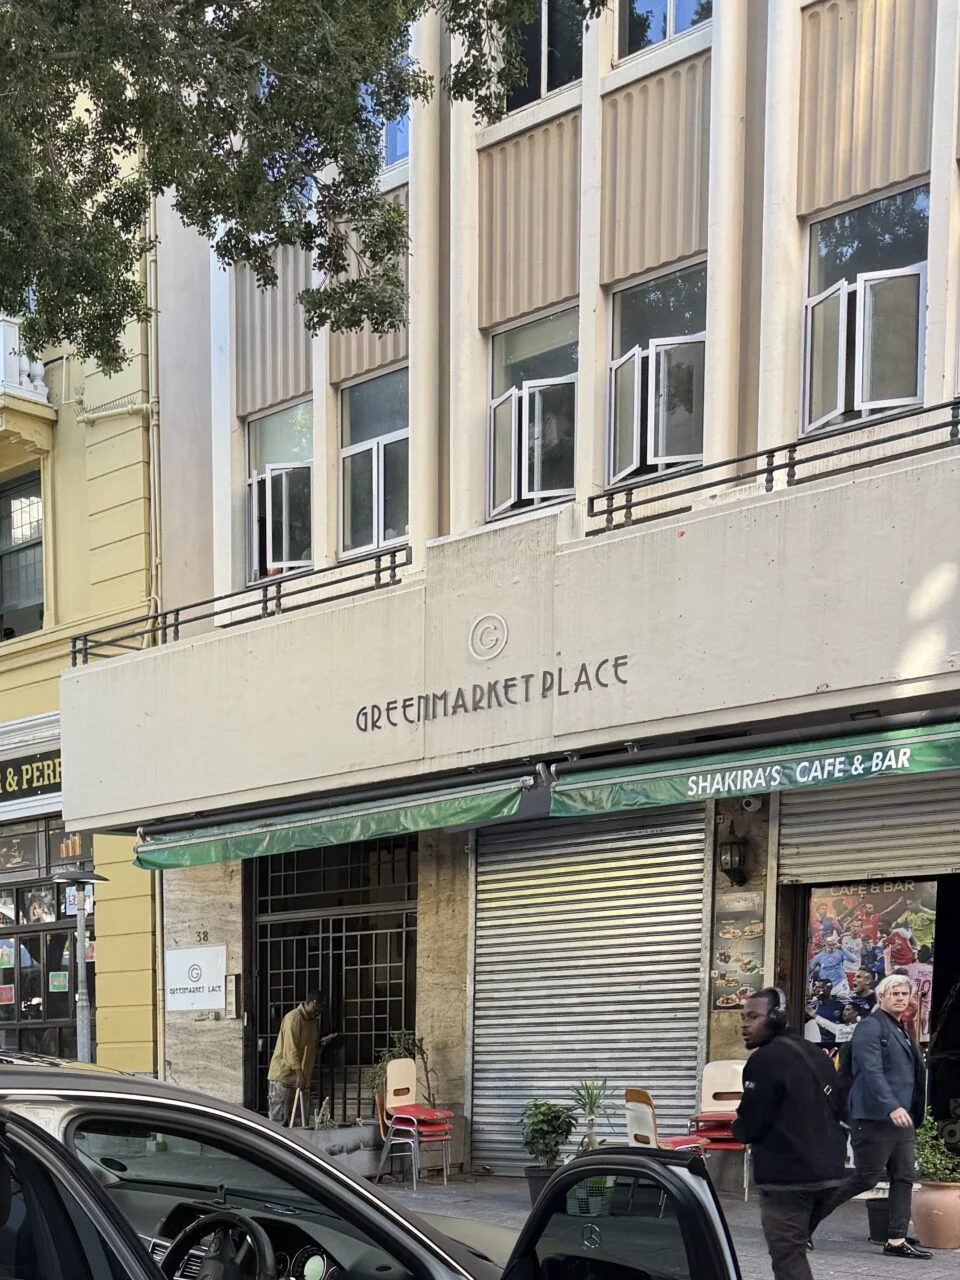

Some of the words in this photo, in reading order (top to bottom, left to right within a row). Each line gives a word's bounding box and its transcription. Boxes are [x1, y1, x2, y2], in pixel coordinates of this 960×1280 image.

[356, 674, 534, 732] GREENMARKET
[541, 654, 629, 700] PLACE
[5, 767, 19, 792] &
[687, 764, 782, 796] SHAKIRA'S
[794, 756, 846, 783] CAFE
[850, 753, 865, 775] &
[871, 747, 912, 772] BAR
[870, 882, 881, 894] &
[883, 879, 916, 893] BAR
[195, 931, 208, 942] 38
